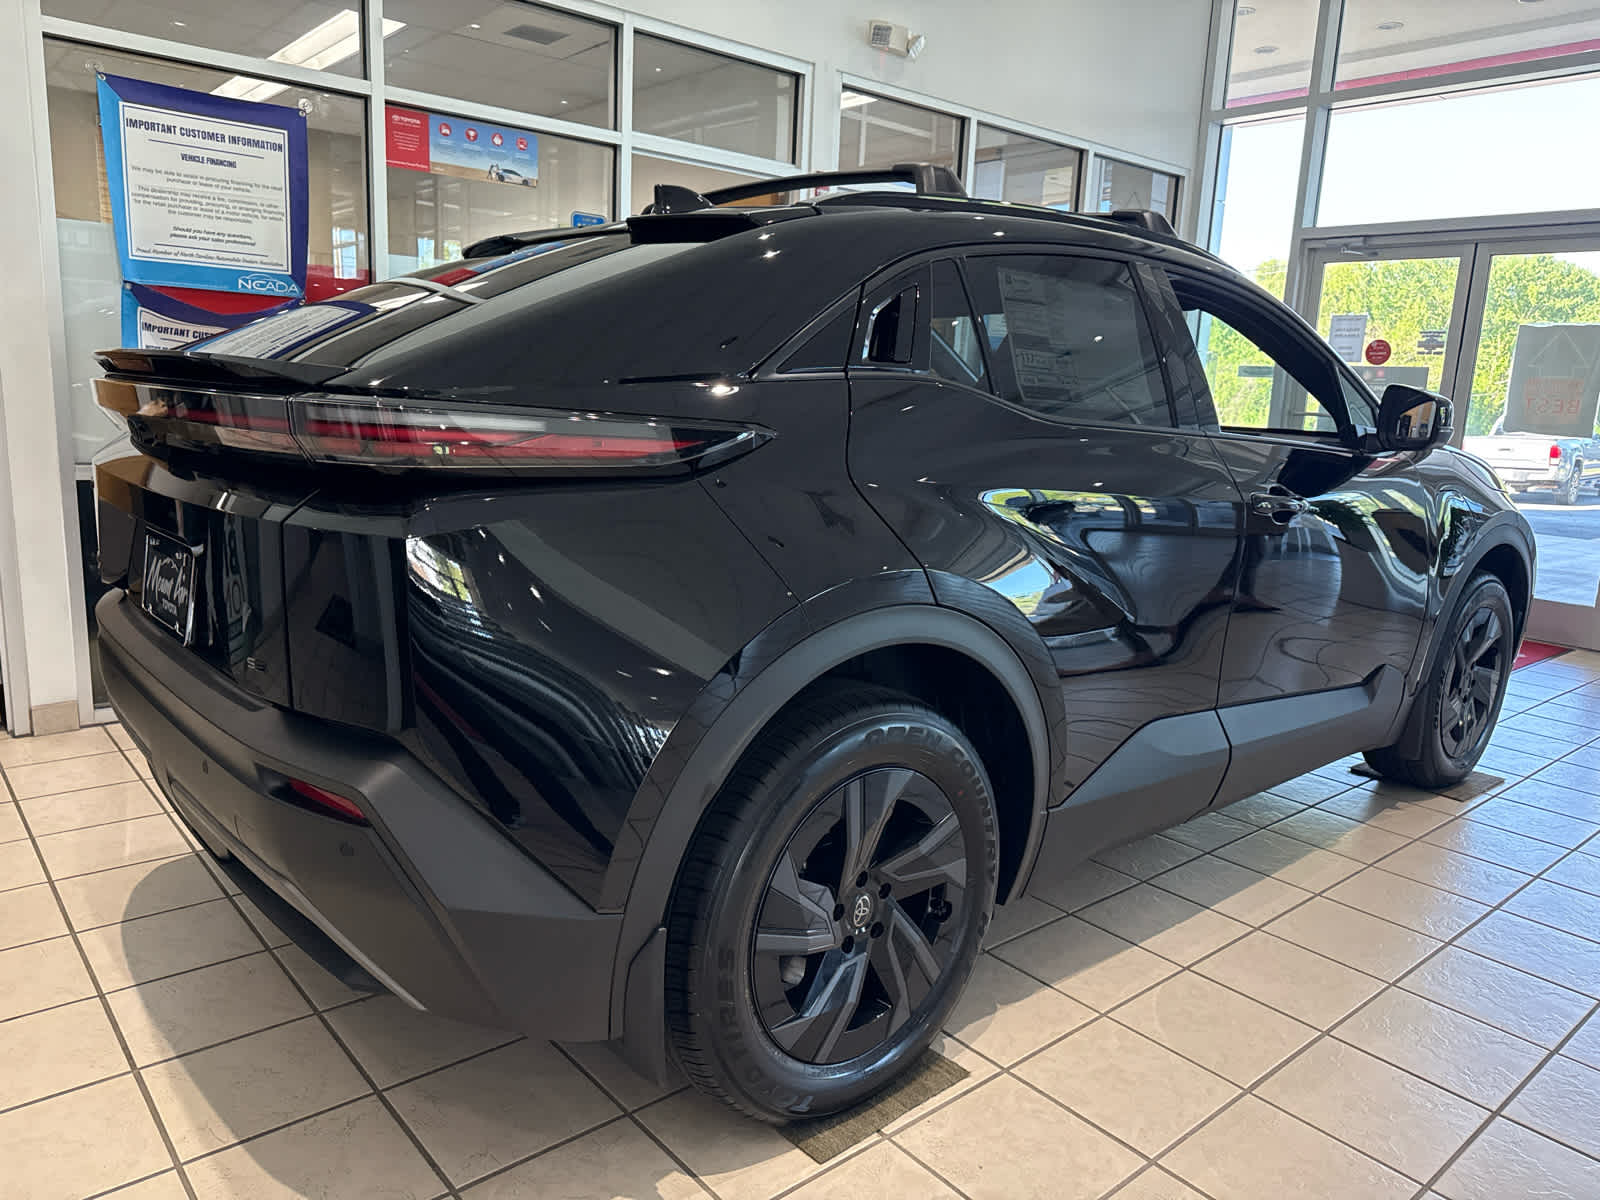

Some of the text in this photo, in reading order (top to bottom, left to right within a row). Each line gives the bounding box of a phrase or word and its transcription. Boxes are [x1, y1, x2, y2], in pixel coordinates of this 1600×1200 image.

[126, 118, 282, 152] IMPORTANT CUSTOMER INFORMATION
[180, 153, 236, 168] VEHICLE FINANCING
[238, 280, 298, 294] NCADA
[142, 322, 190, 338] IMPORTANT
